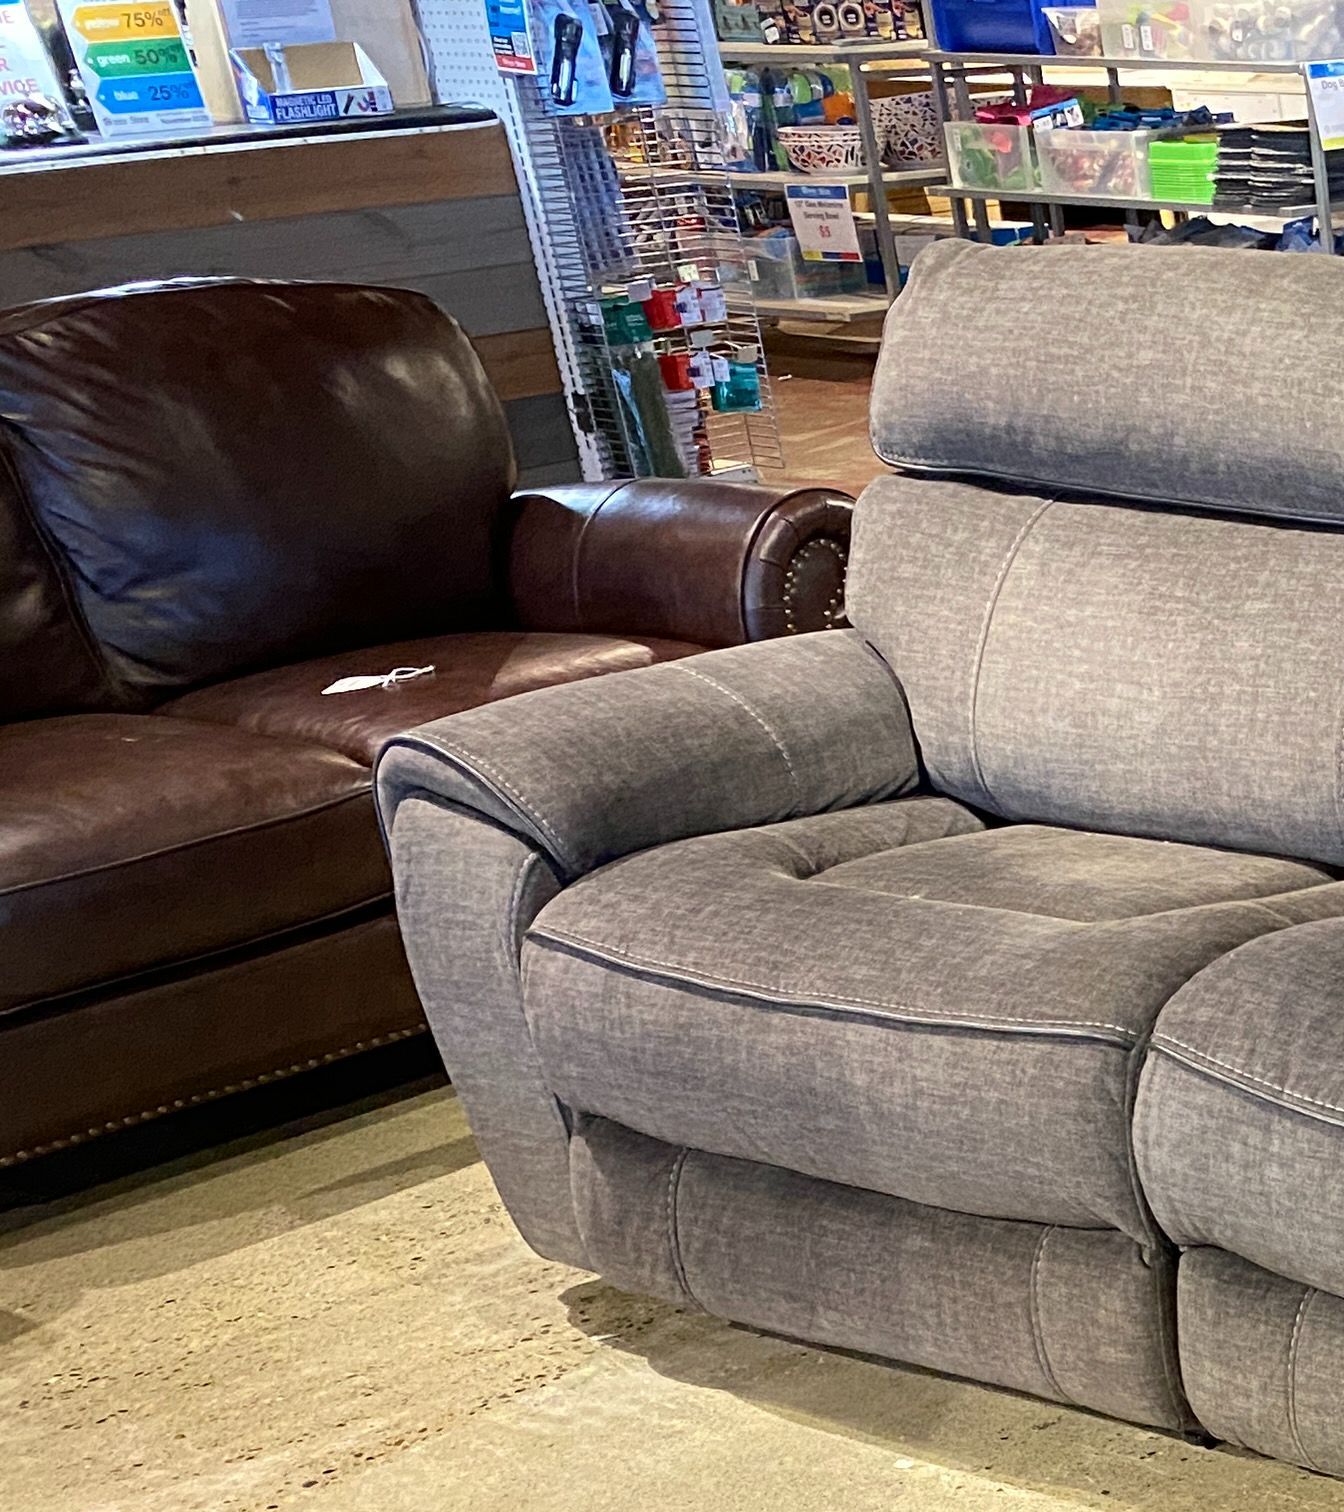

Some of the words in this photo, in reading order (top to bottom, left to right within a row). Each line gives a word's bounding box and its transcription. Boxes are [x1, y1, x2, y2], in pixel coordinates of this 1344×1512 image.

[121, 9, 164, 29] 75%
[96, 54, 131, 68] green
[133, 47, 178, 65] 50%
[147, 84, 190, 101] 25%
[1320, 79, 1338, 91] Dog
[315, 93, 333, 105] LED
[275, 103, 337, 120] FLASHLIGHT
